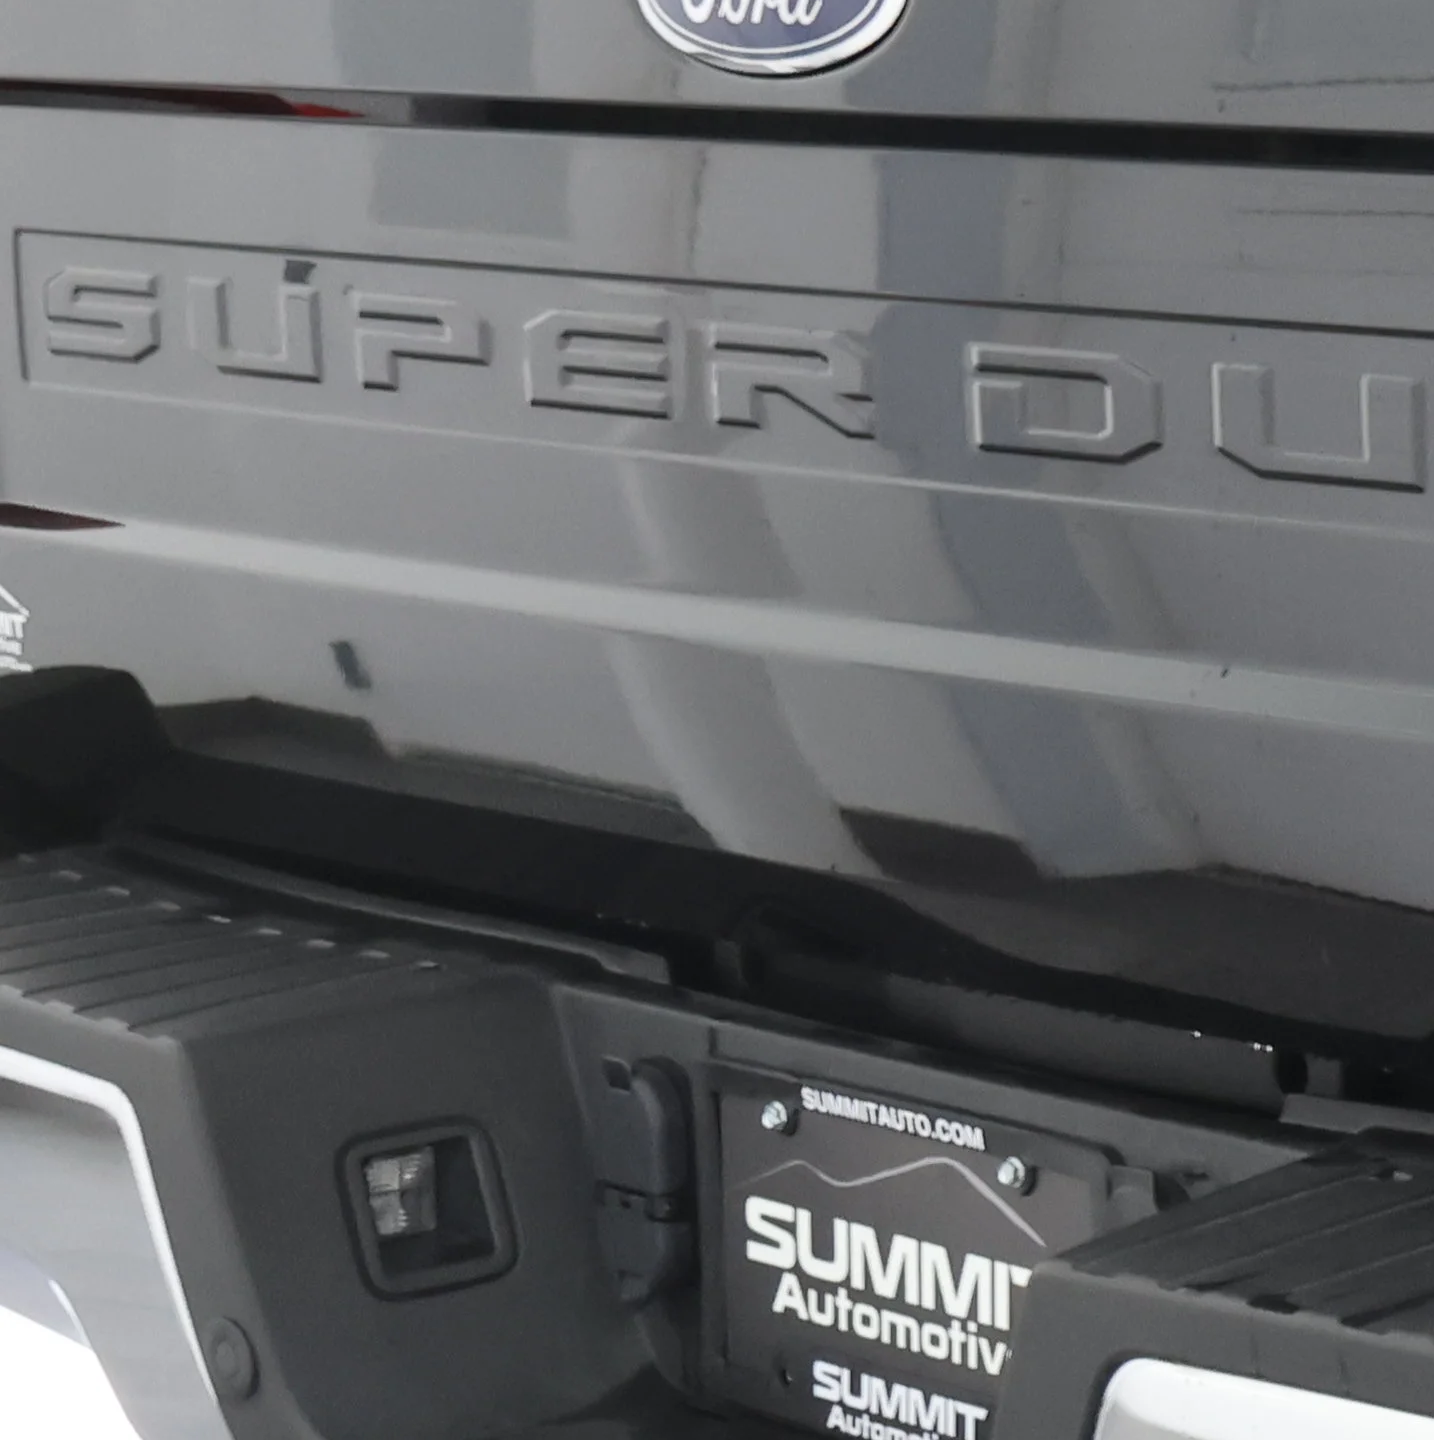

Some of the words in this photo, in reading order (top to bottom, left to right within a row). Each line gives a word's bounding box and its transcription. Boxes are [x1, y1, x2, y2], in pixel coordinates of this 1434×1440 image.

[42, 263, 880, 440] SUPER
[801, 1085, 986, 1151] SUMMITAUTO.COM
[772, 1271, 1012, 1376] Automotiv
